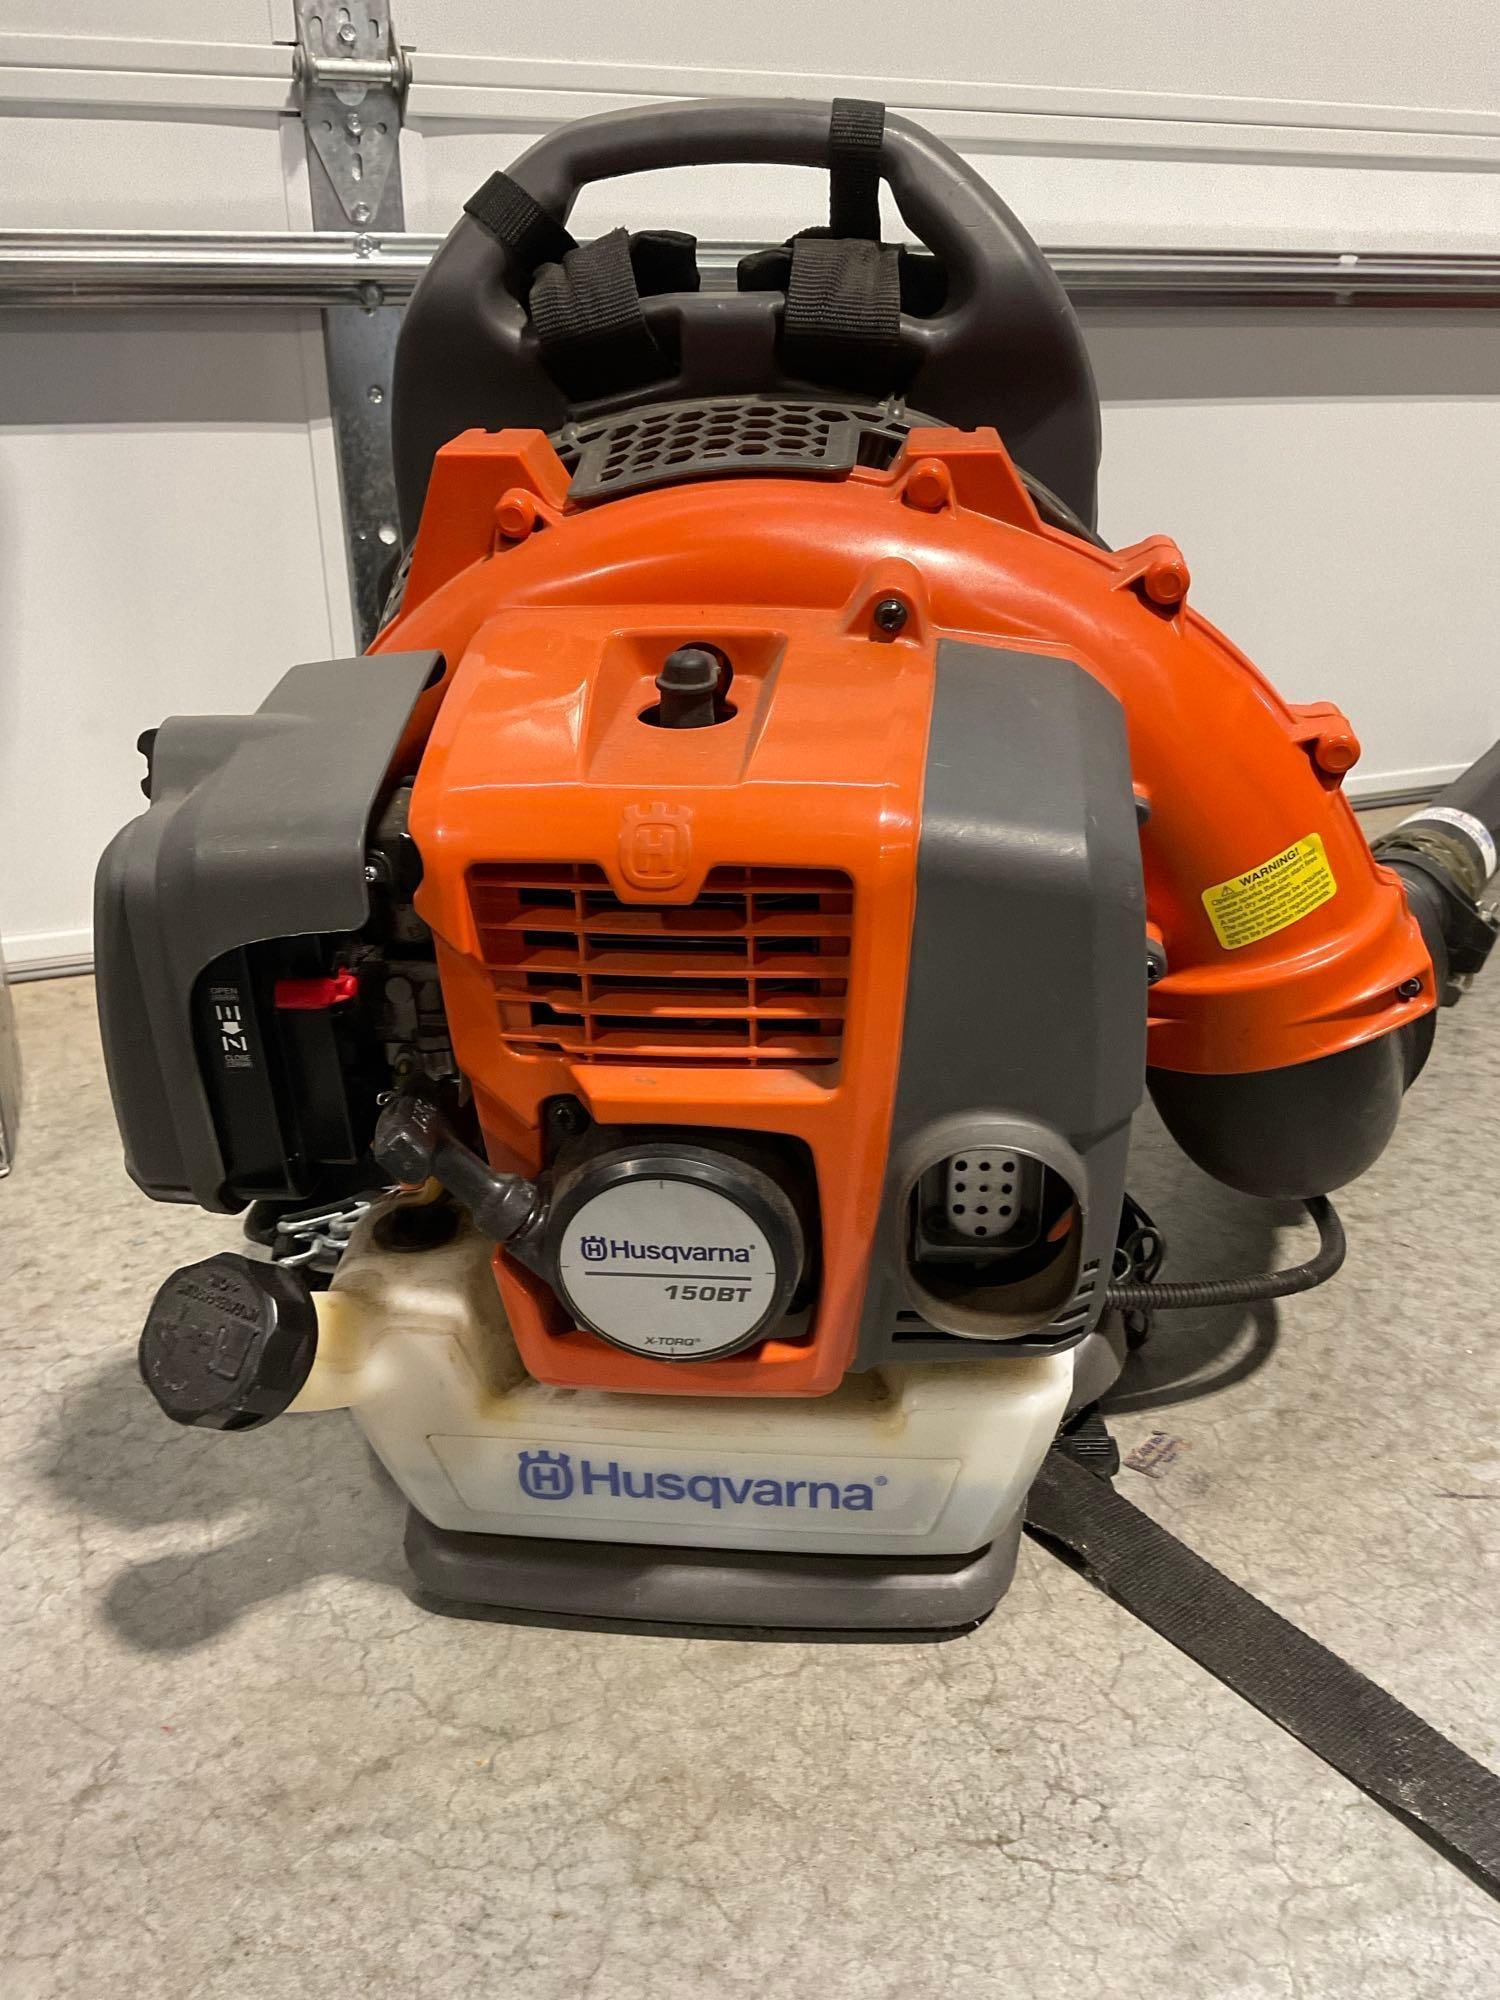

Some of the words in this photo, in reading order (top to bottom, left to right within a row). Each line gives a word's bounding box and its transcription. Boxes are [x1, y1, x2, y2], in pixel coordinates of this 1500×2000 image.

[1239, 847, 1300, 886] WARNING!
[664, 1285, 752, 1303] 150BT
[581, 1460, 874, 1511] Husqvarna
